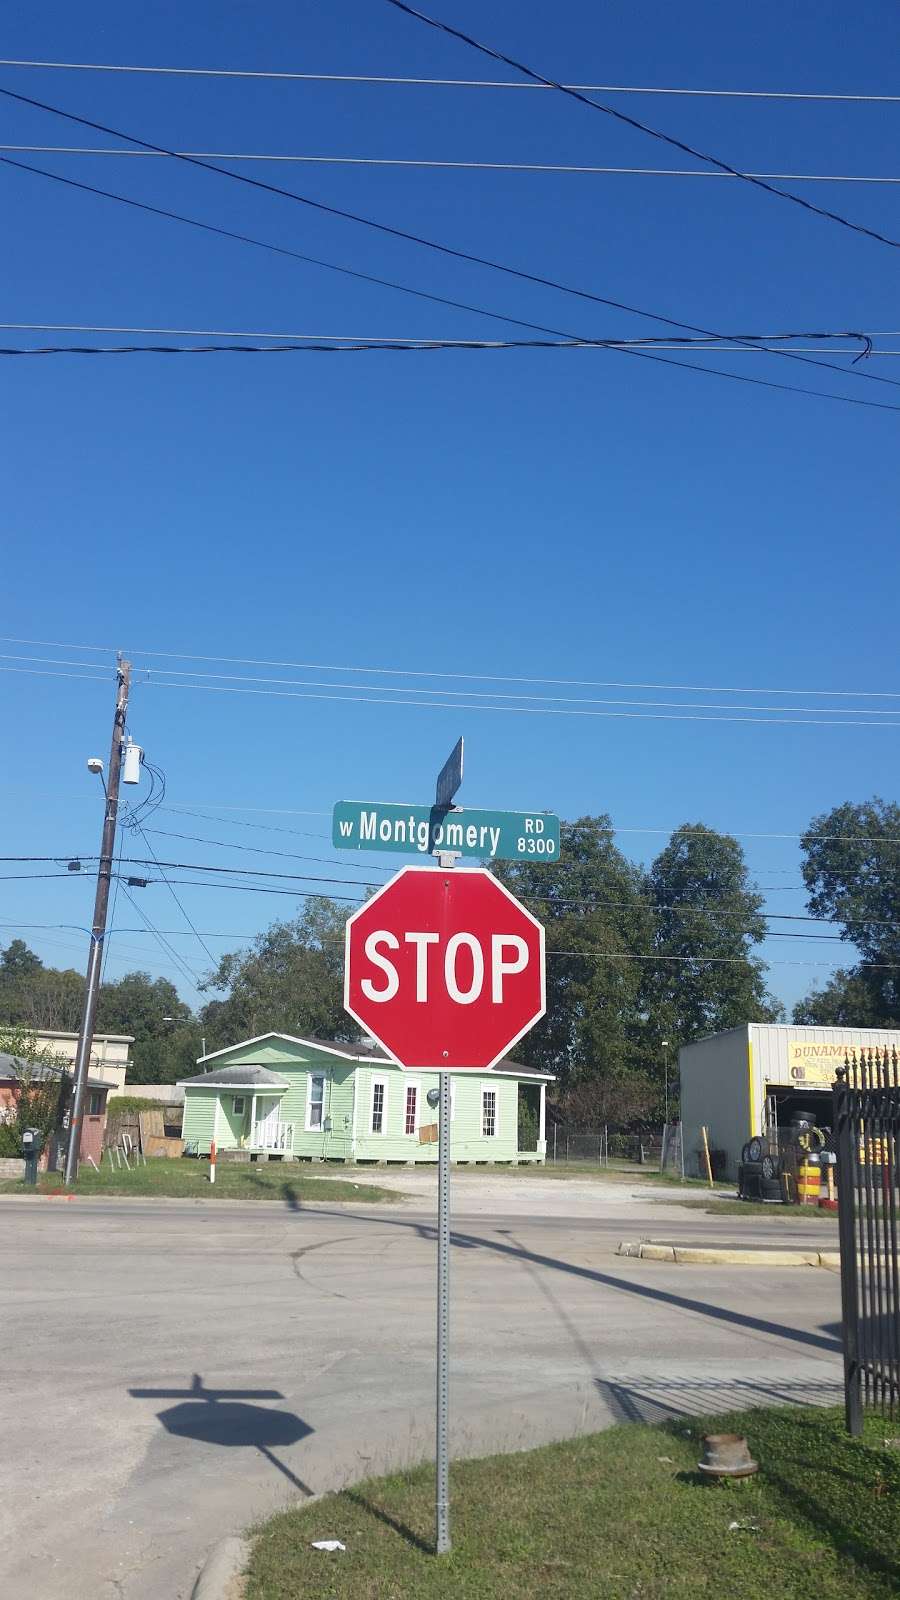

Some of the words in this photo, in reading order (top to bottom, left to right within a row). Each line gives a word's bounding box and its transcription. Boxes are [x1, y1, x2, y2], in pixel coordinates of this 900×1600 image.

[359, 811, 501, 856] Montgomery
[525, 819, 545, 834] RD
[517, 838, 555, 854] 8300
[360, 930, 530, 1005] STOP
[795, 1046, 857, 1058] DUNAMIS
